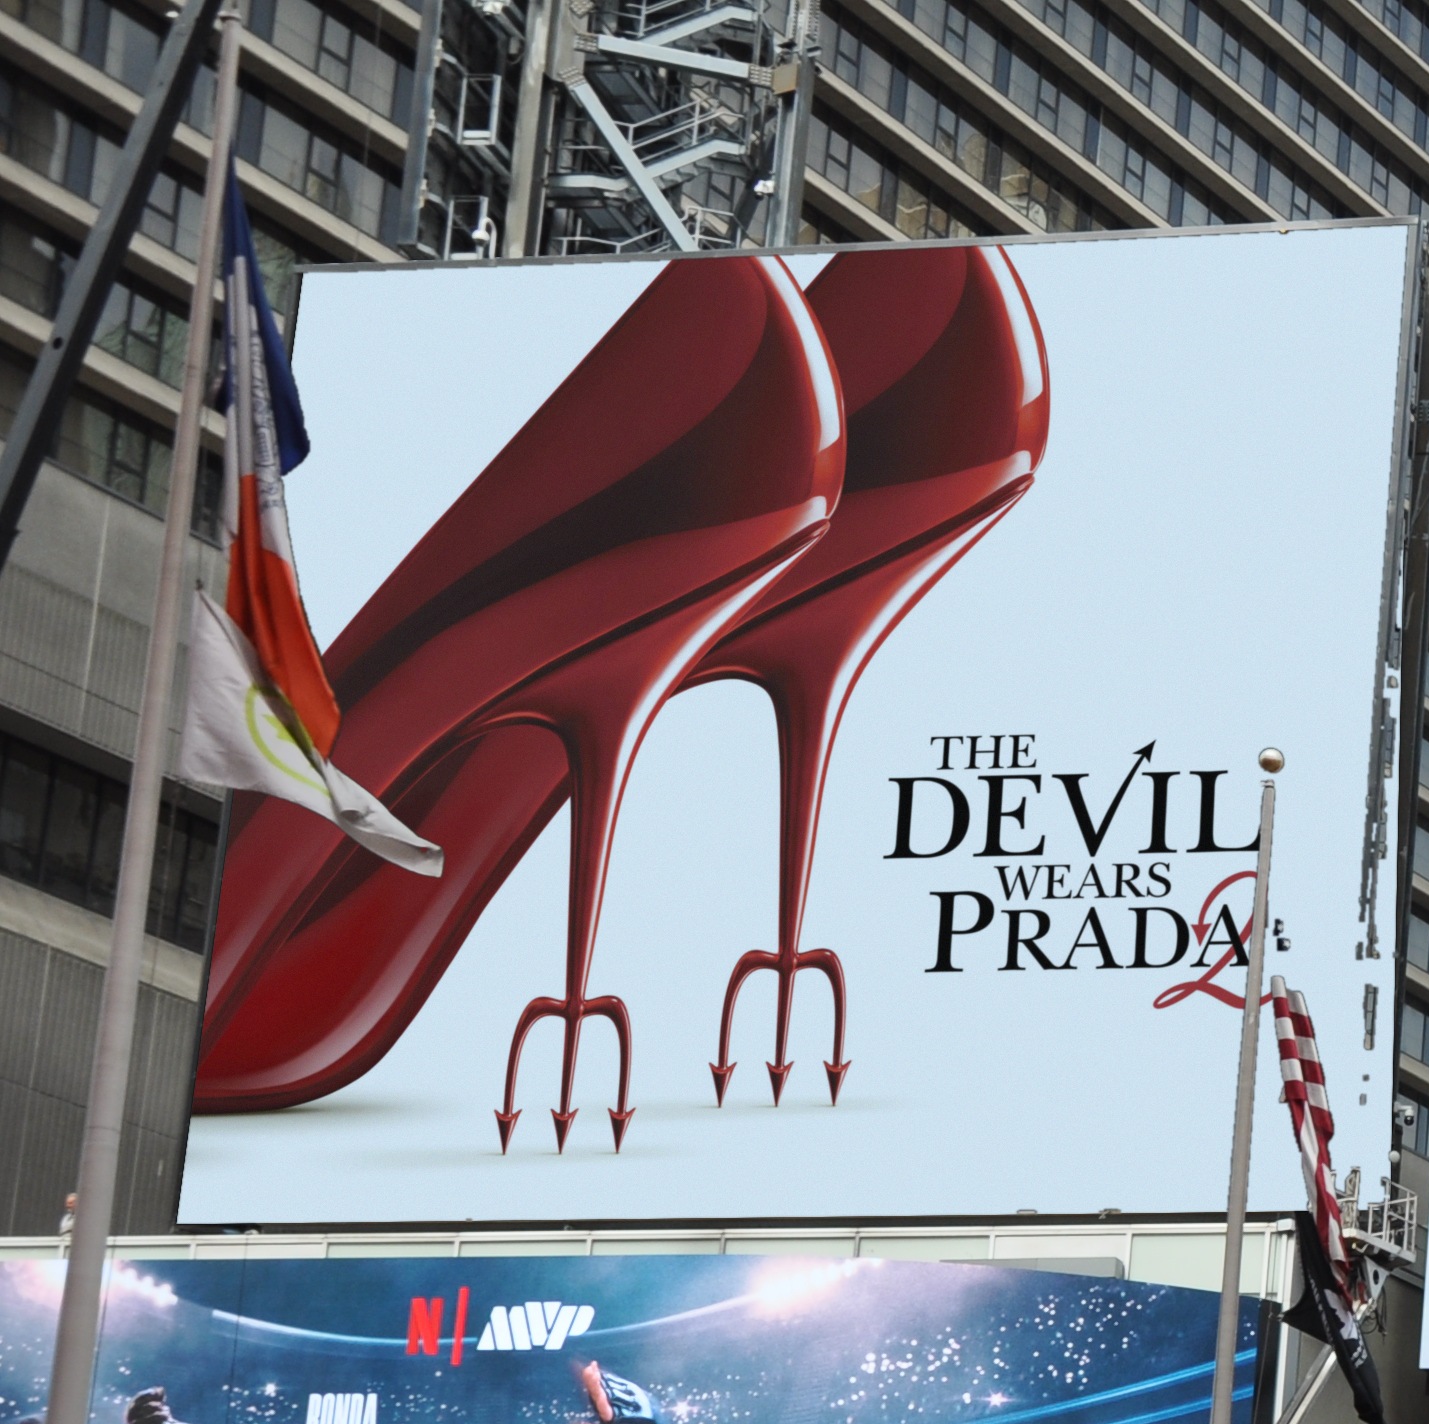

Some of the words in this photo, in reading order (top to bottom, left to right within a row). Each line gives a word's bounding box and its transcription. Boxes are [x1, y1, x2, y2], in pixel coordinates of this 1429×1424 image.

[931, 734, 1038, 771] THE
[883, 739, 1262, 860] DEVIL
[993, 862, 1173, 902] WEARS
[924, 890, 1251, 973] PRADA
